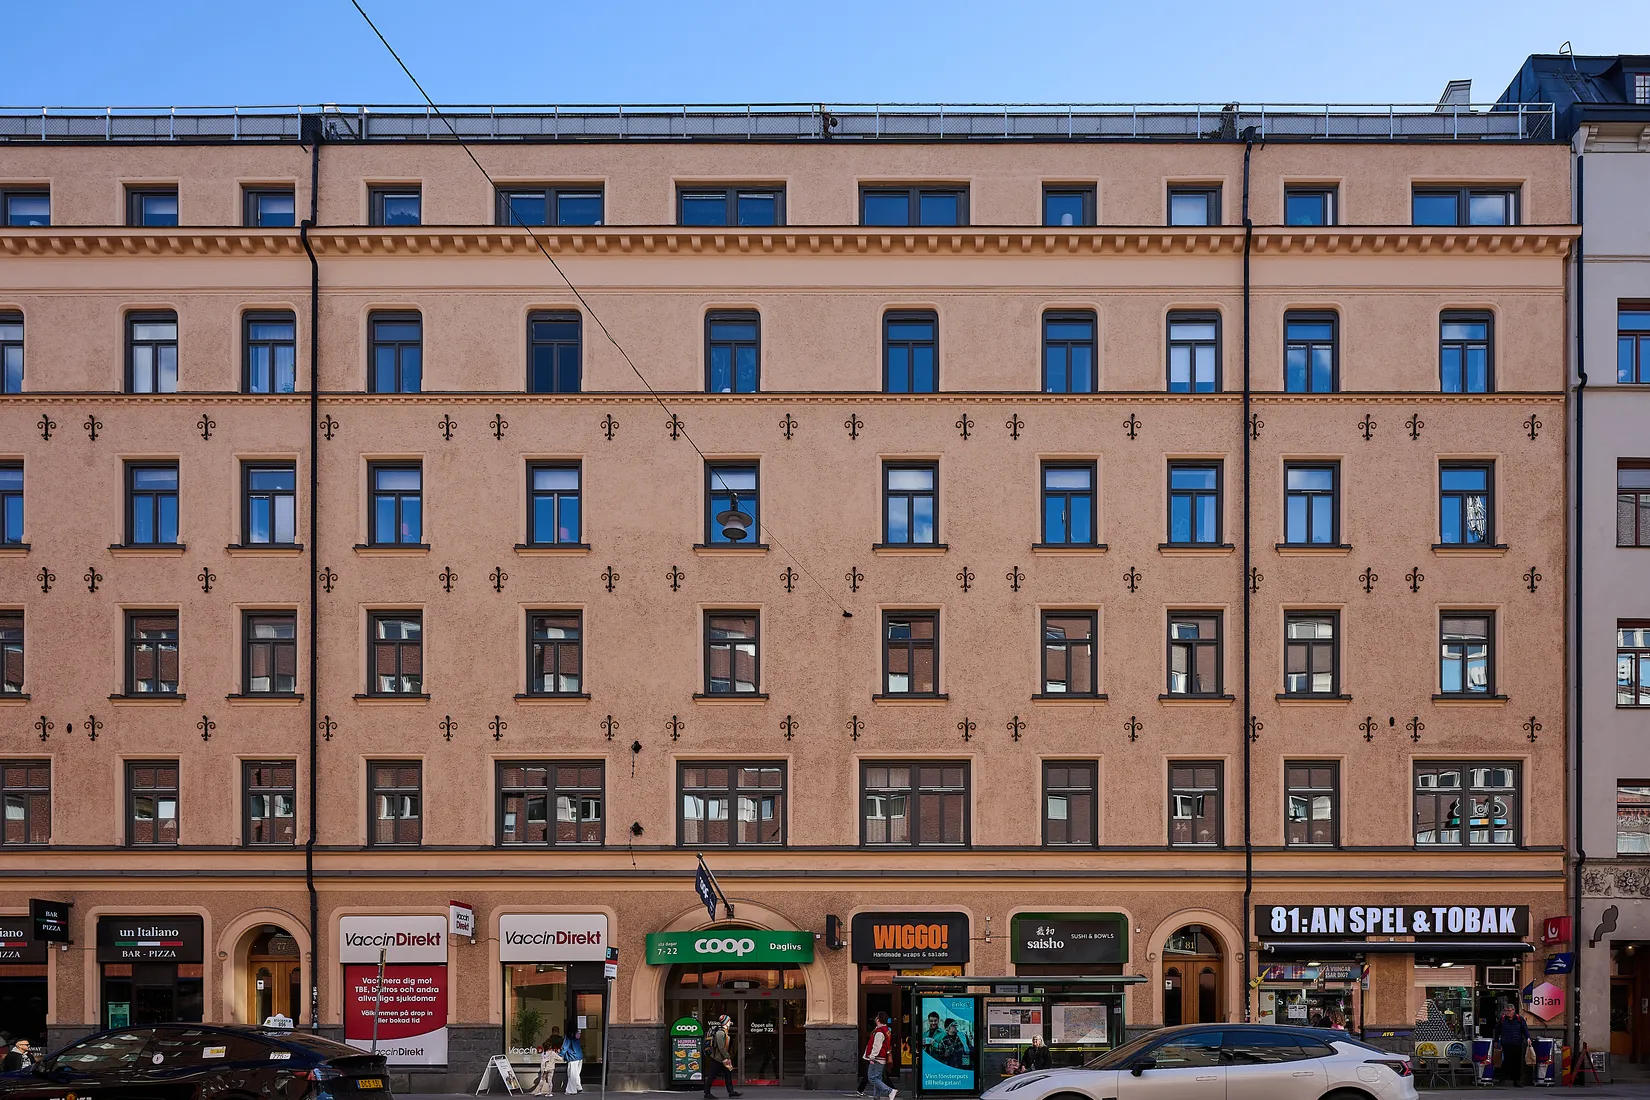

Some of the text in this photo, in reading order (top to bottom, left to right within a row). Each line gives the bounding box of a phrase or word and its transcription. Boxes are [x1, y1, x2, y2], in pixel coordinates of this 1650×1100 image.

[456, 912, 469, 921] Vaccin
[1270, 906, 1517, 933] 81:AN SPEL & TOBAK
[456, 920, 469, 931] Direkt
[120, 926, 179, 937] un Italiano
[873, 924, 948, 950] WIGGO!
[345, 932, 441, 946] VaccinDirekt
[505, 931, 601, 945] VaccinDirekt
[1027, 937, 1064, 949] saisho
[694, 938, 755, 956] coop
[770, 942, 802, 951] Daglivs
[402, 977, 416, 985] dig
[358, 995, 437, 1004] allvaliga sjukdomar
[1533, 996, 1560, 1006] 81:an
[370, 1048, 424, 1056] accinDirekt
